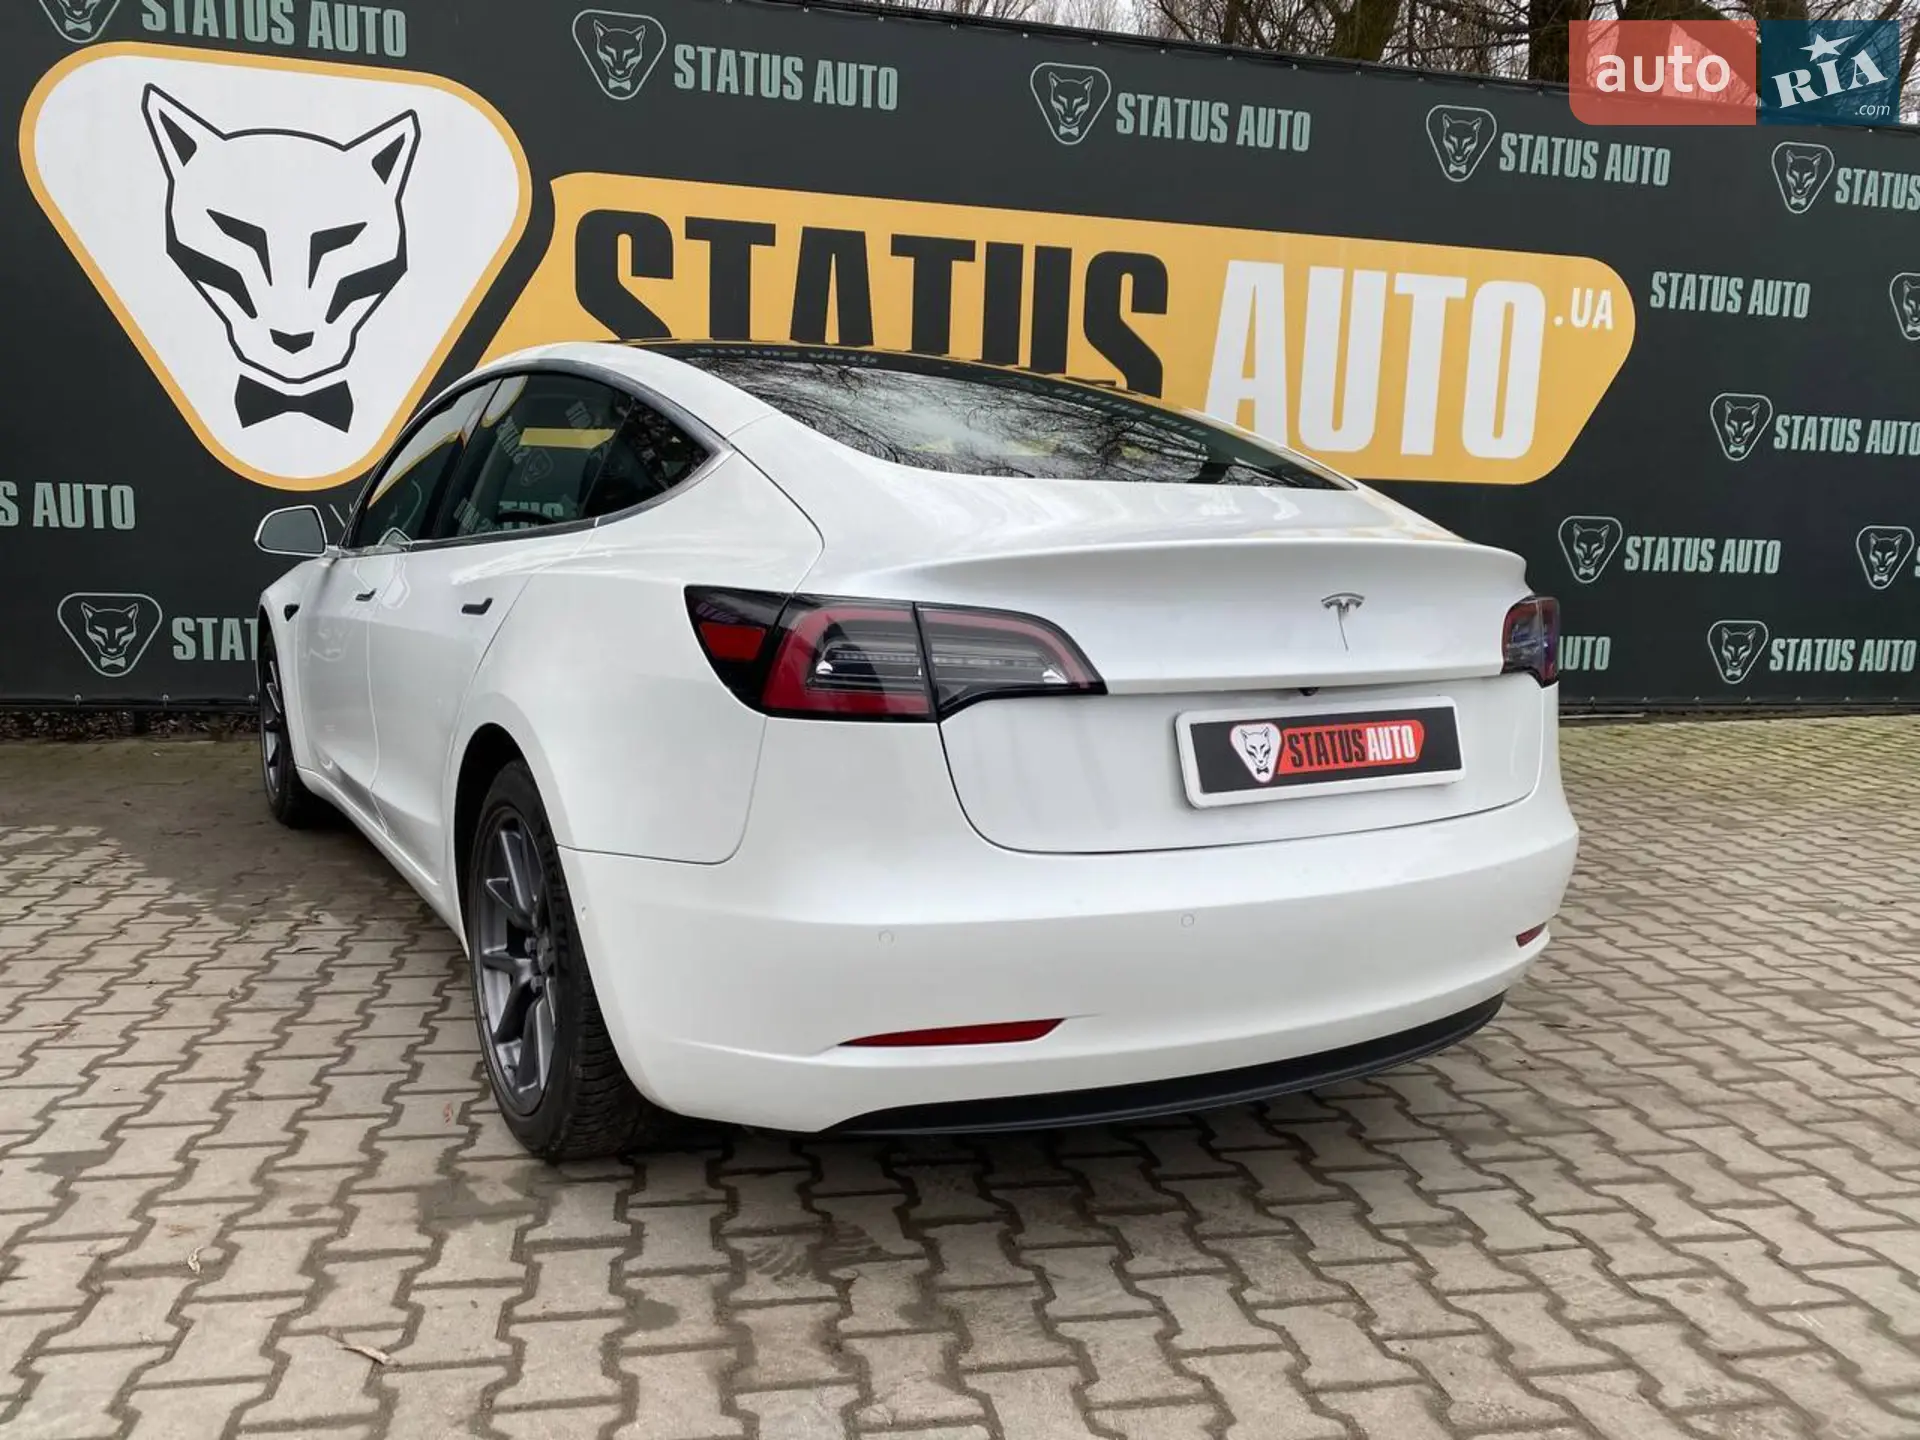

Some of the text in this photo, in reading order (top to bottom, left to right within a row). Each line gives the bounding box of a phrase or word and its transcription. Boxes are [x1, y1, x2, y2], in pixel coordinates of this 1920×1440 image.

[141, 0, 407, 57] STATUS AUTO
[674, 43, 899, 111] STATUS AUTO
[1116, 92, 1311, 152] STATUS AUTO
[1500, 132, 1671, 187] STATUS AUTO
[1835, 167, 1920, 211] STATUS
[1650, 271, 1811, 319] STATUS AUTO
[574, 208, 1169, 399] STATUS
[1203, 259, 1547, 460] AUTO
[1773, 414, 1920, 456] STATUS AUTO
[33, 482, 136, 530] AUTO
[1624, 535, 1782, 574] STATUS AUTO
[172, 617, 259, 661] STAT
[1769, 638, 1917, 673] STATUS AUTO
[1286, 724, 1417, 769] STATUS AUTO
